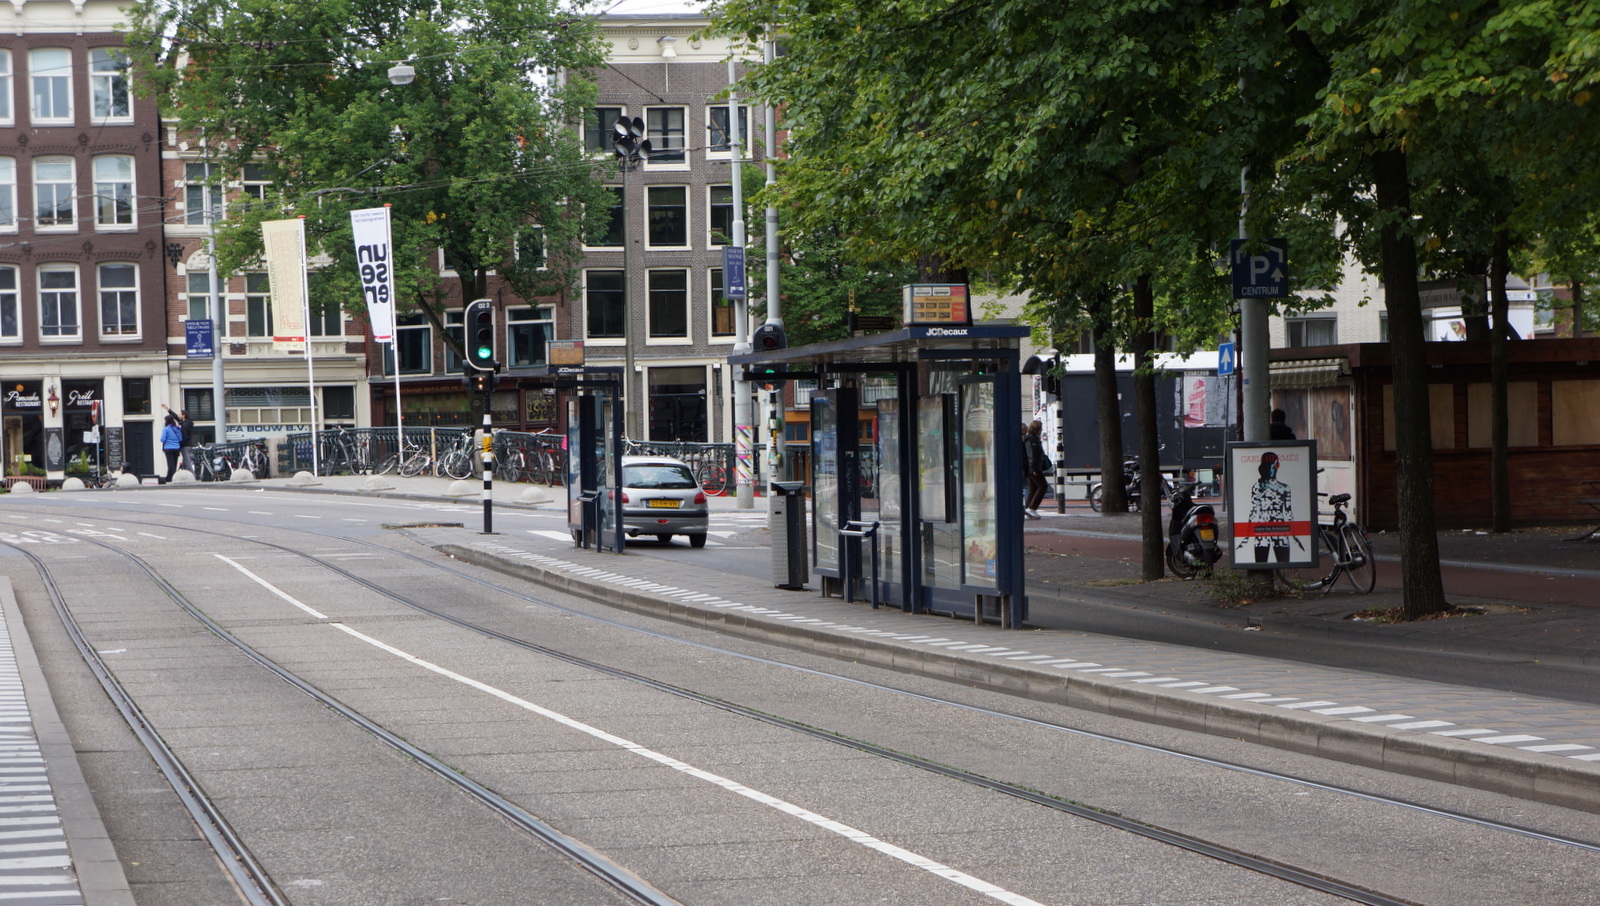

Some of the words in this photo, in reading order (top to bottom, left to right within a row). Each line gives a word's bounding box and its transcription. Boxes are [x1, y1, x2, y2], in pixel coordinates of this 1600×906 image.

[1250, 255, 1270, 285] P
[1241, 286, 1279, 296] CENTRUM
[926, 328, 968, 336] JCDecaux
[4, 391, 40, 402] Pancake
[67, 390, 94, 406] Grill
[15, 400, 42, 408] RESTAURANT
